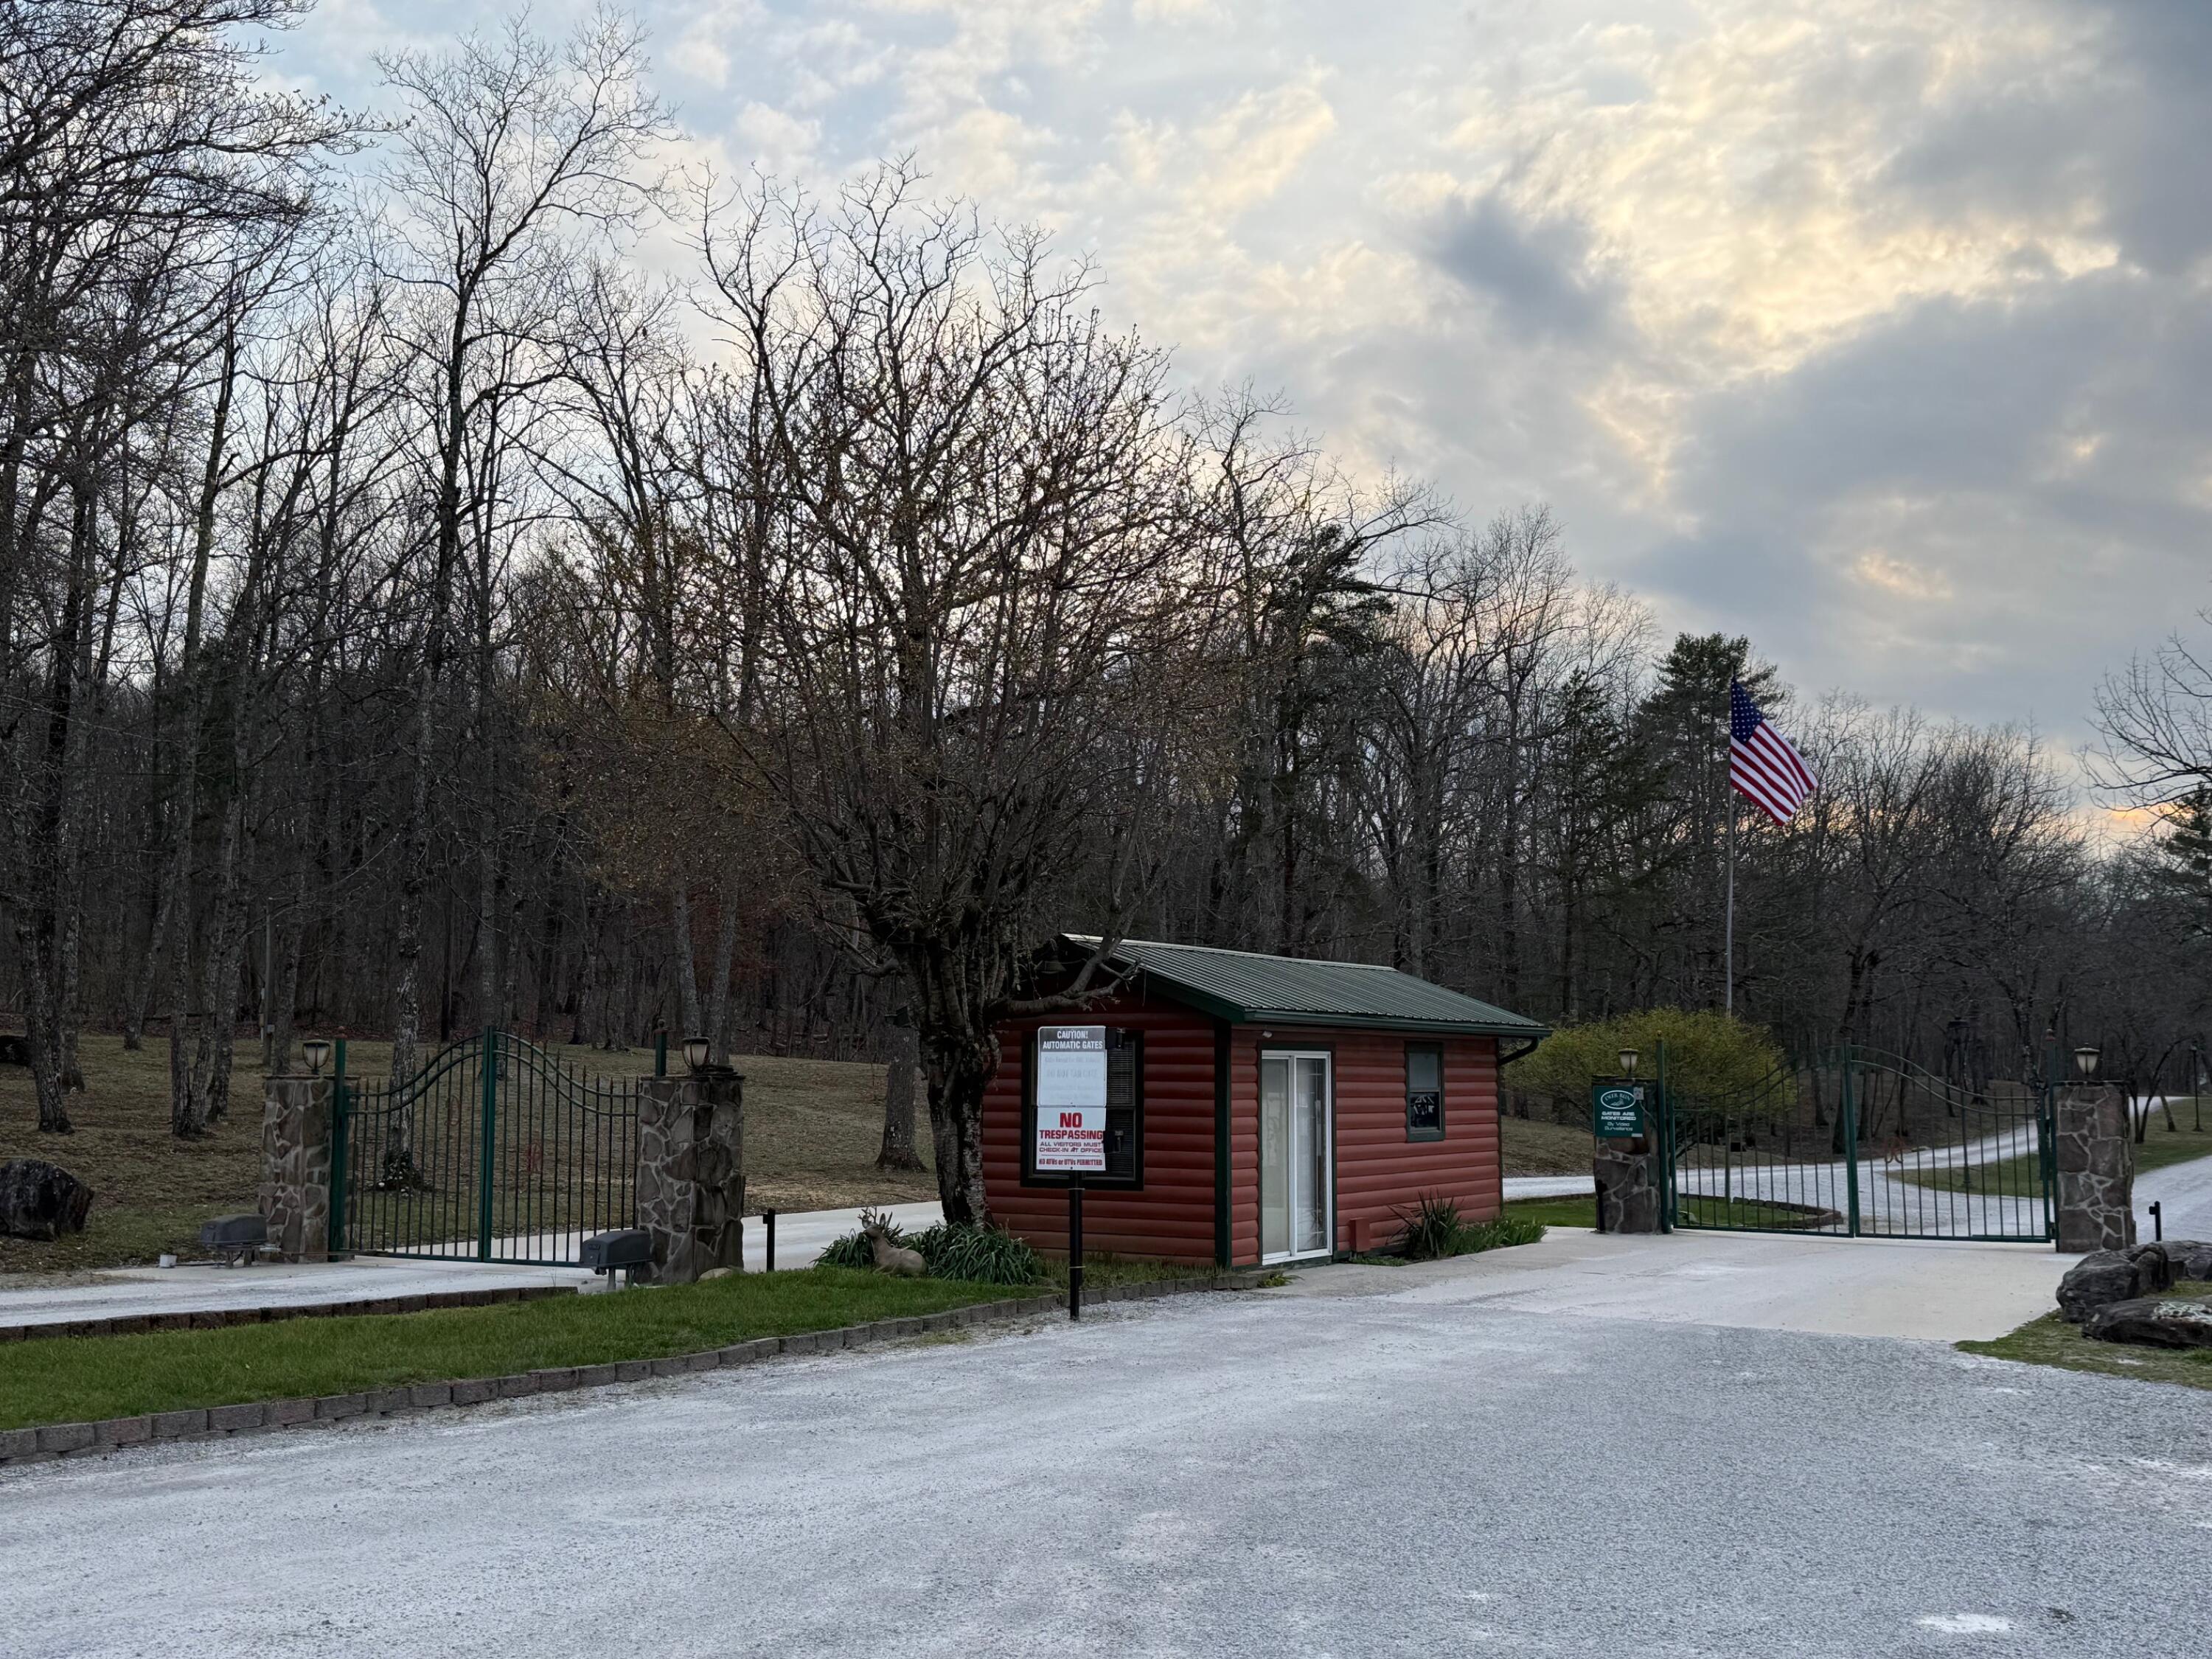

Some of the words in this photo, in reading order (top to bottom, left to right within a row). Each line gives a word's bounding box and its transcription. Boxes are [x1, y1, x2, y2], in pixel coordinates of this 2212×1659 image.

[1057, 1030, 1088, 1039] CAUTION!
[1043, 1041, 1080, 1049] AUTOMATIC
[1082, 1041, 1103, 1049] GATES
[1060, 1113, 1082, 1127] NO
[1039, 1130, 1103, 1139] TRESPASSING
